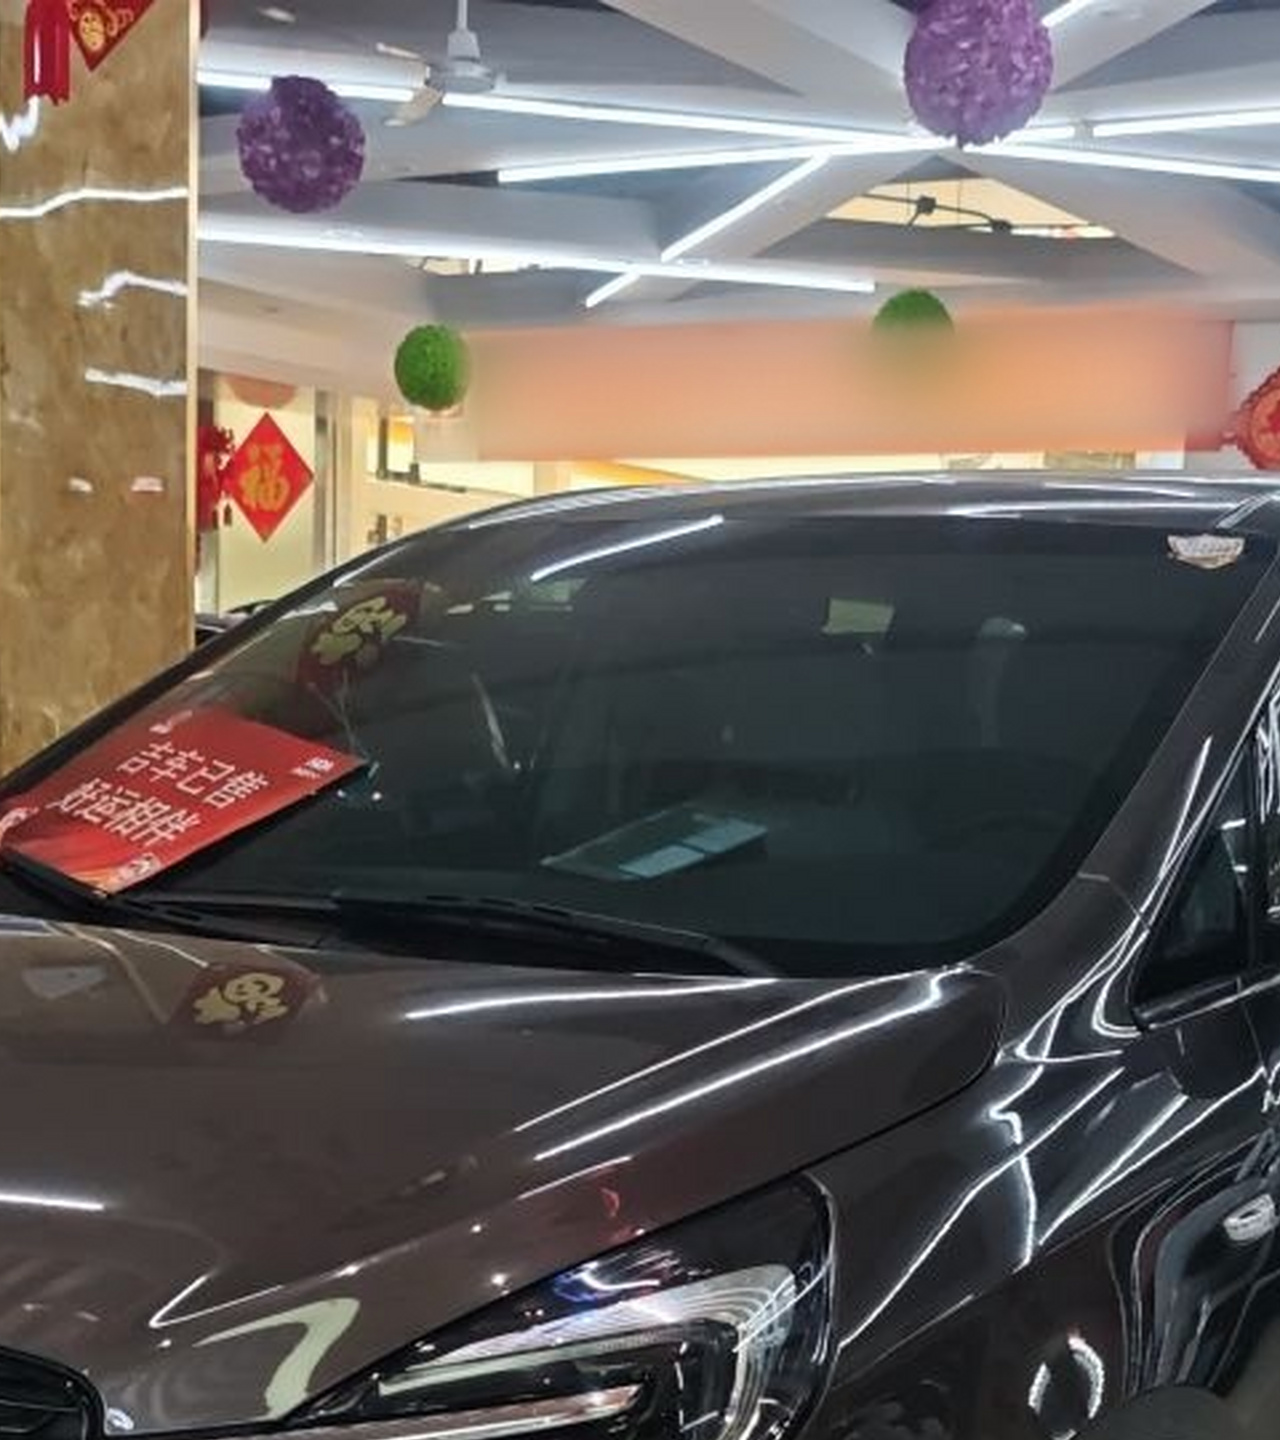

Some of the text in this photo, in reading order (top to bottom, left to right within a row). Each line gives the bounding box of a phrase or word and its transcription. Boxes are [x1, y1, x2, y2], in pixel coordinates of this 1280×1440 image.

[115, 741, 269, 808] 吉车已售
[45, 778, 200, 847] 好运相伴
